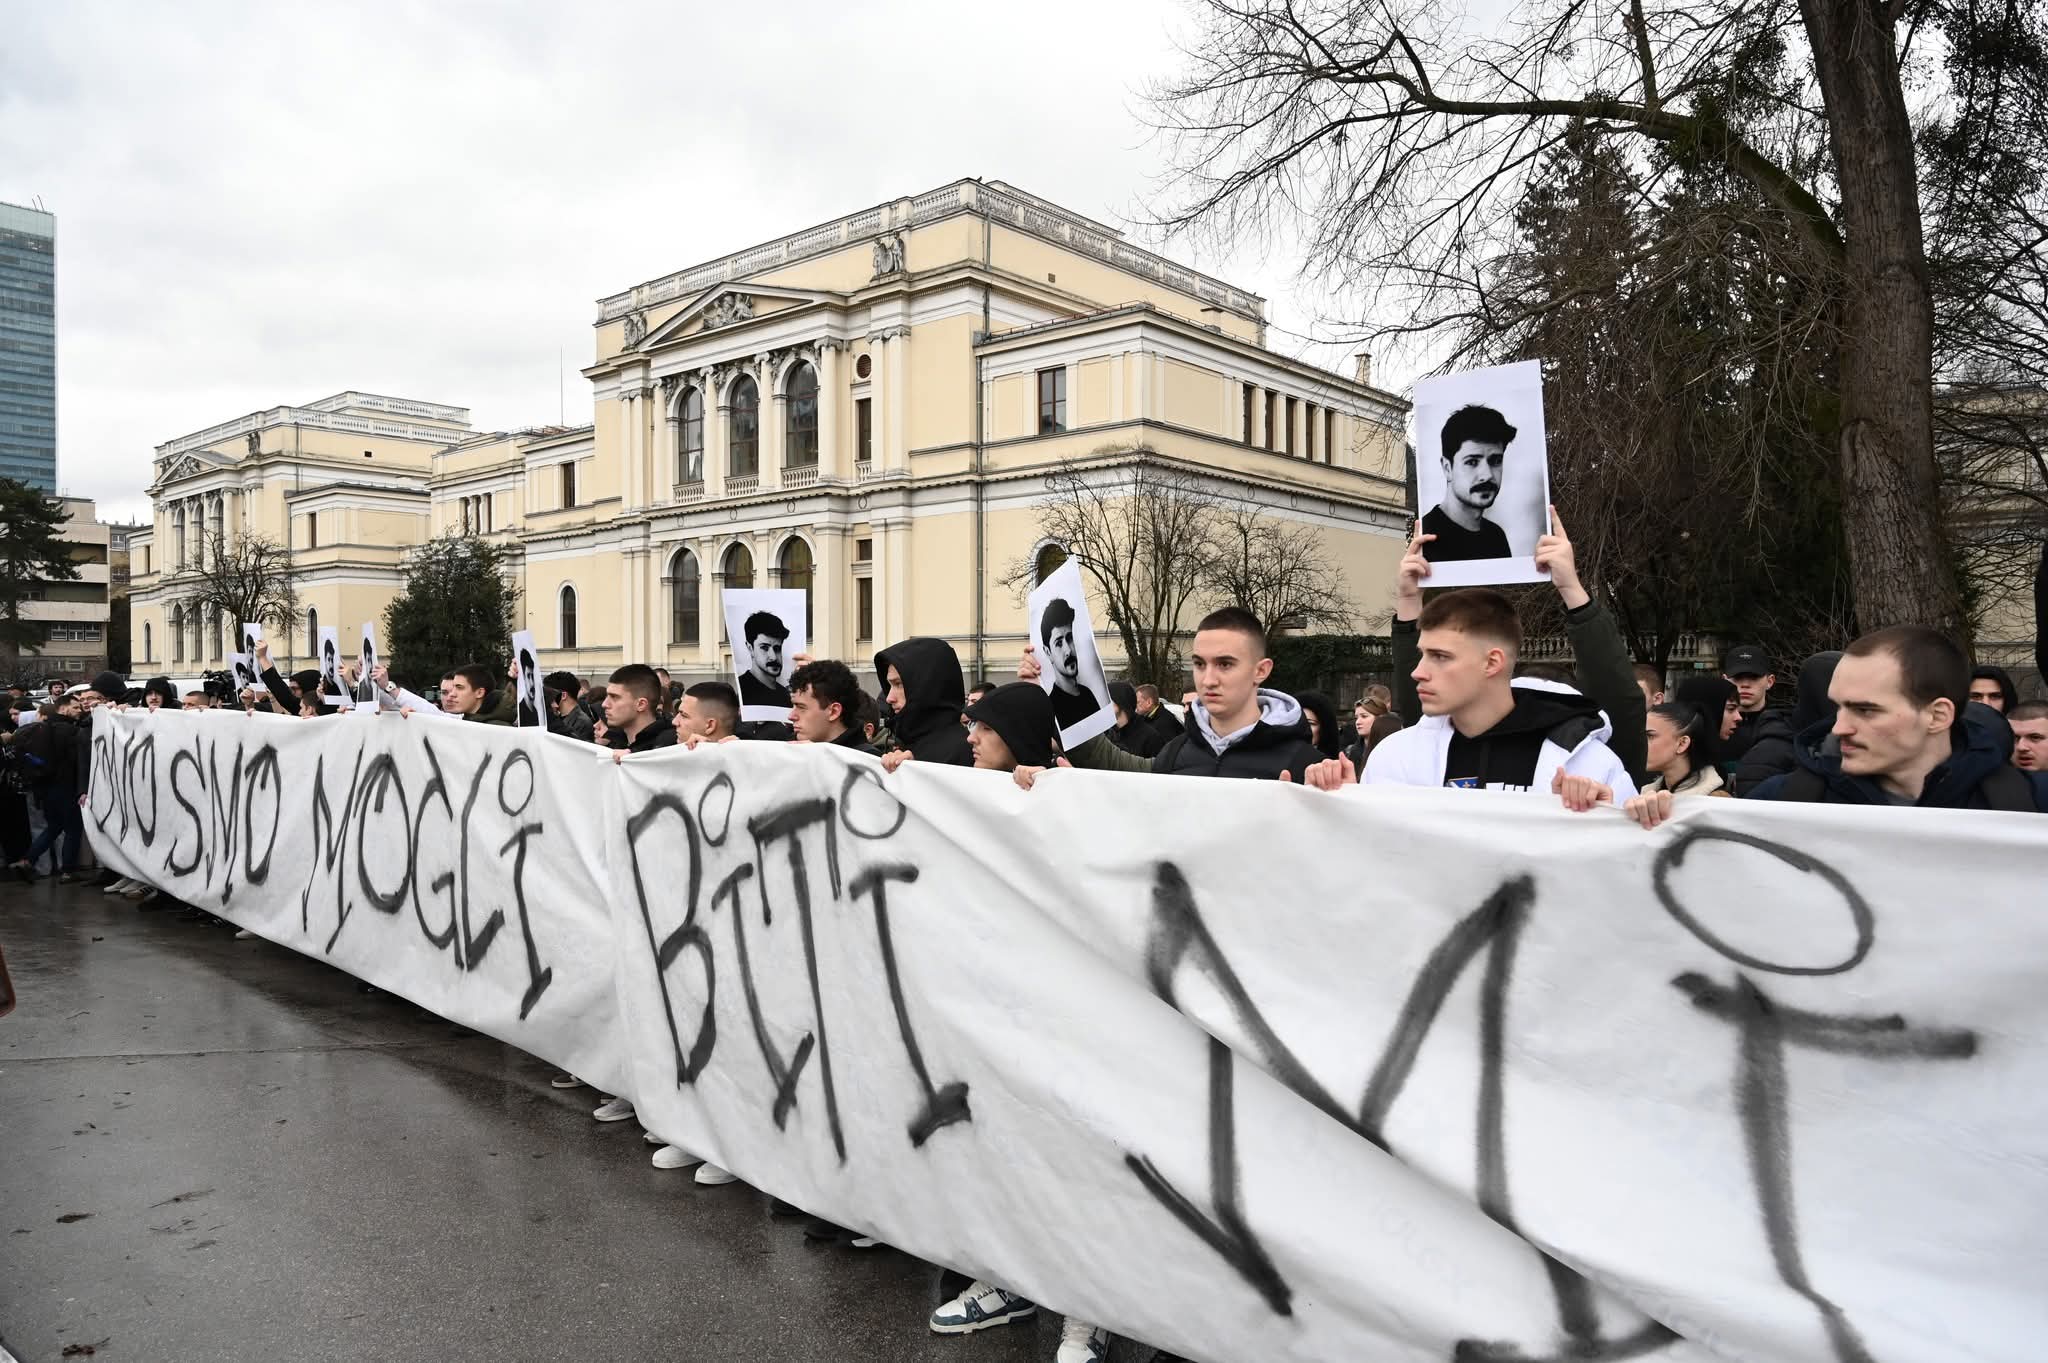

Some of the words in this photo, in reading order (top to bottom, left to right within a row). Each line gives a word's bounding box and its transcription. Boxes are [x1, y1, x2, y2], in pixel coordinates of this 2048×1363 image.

[90, 727, 157, 848] OVO
[164, 735, 282, 905] SMO
[301, 732, 553, 1021] MOGLI
[626, 763, 973, 1168] BITI
[1123, 825, 1979, 1363] MI
